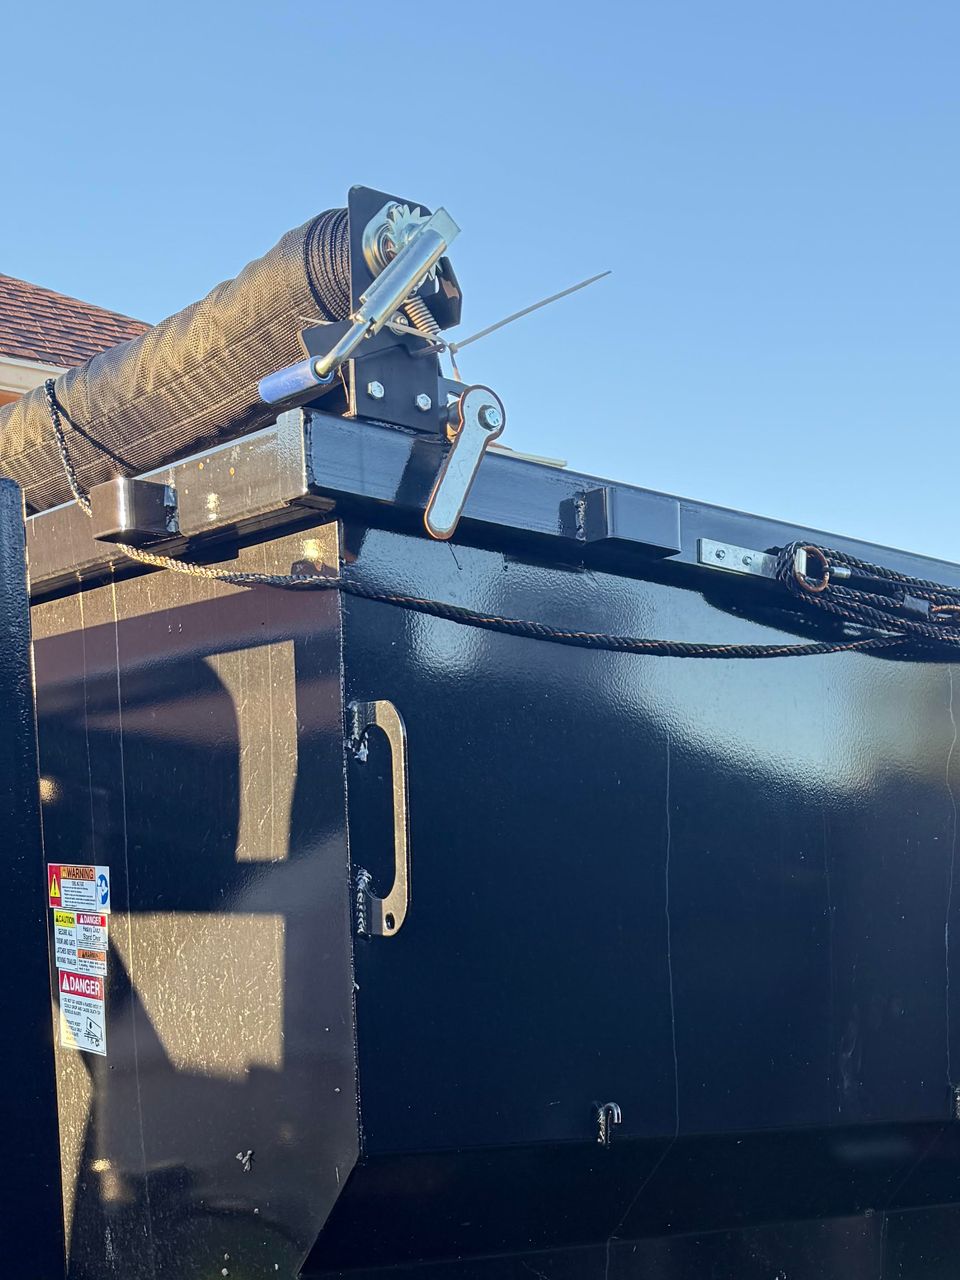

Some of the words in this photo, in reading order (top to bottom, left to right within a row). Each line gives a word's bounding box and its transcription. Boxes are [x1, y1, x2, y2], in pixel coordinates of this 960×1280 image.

[67, 867, 94, 879] WARNING
[84, 915, 102, 926] DANGER
[70, 977, 101, 996] DANGER
